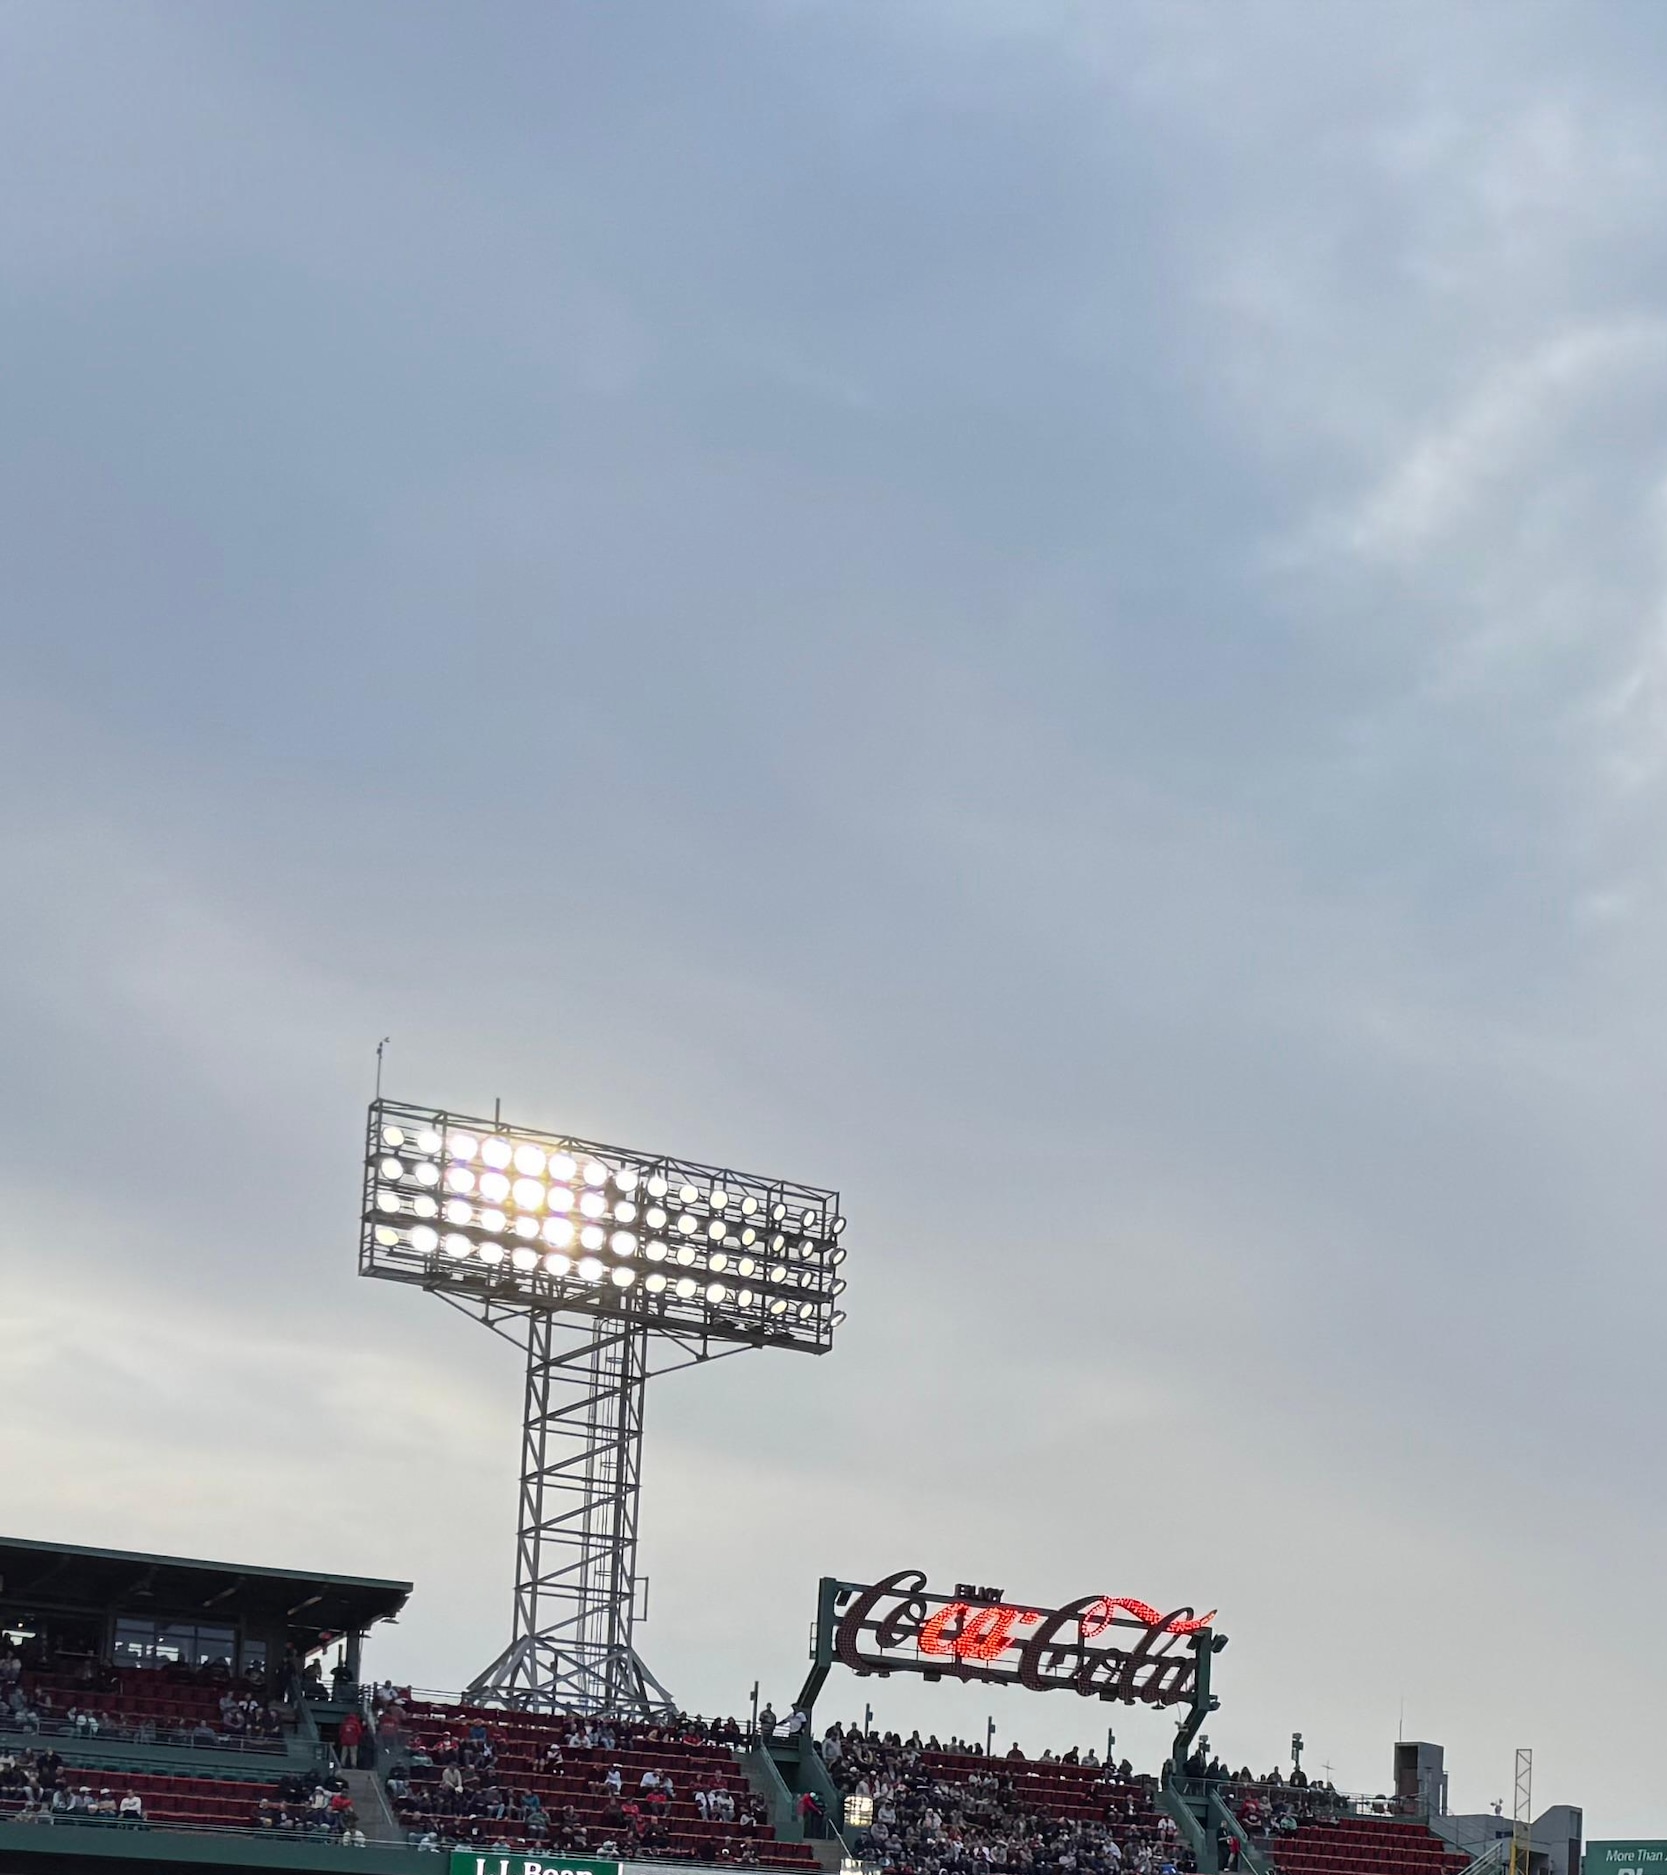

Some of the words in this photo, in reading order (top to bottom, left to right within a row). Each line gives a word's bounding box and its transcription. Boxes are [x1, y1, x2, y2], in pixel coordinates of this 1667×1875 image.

[834, 1570, 1218, 1706] Coca-Cola
[1606, 1850, 1635, 1862] More
[1636, 1849, 1663, 1861] Than
